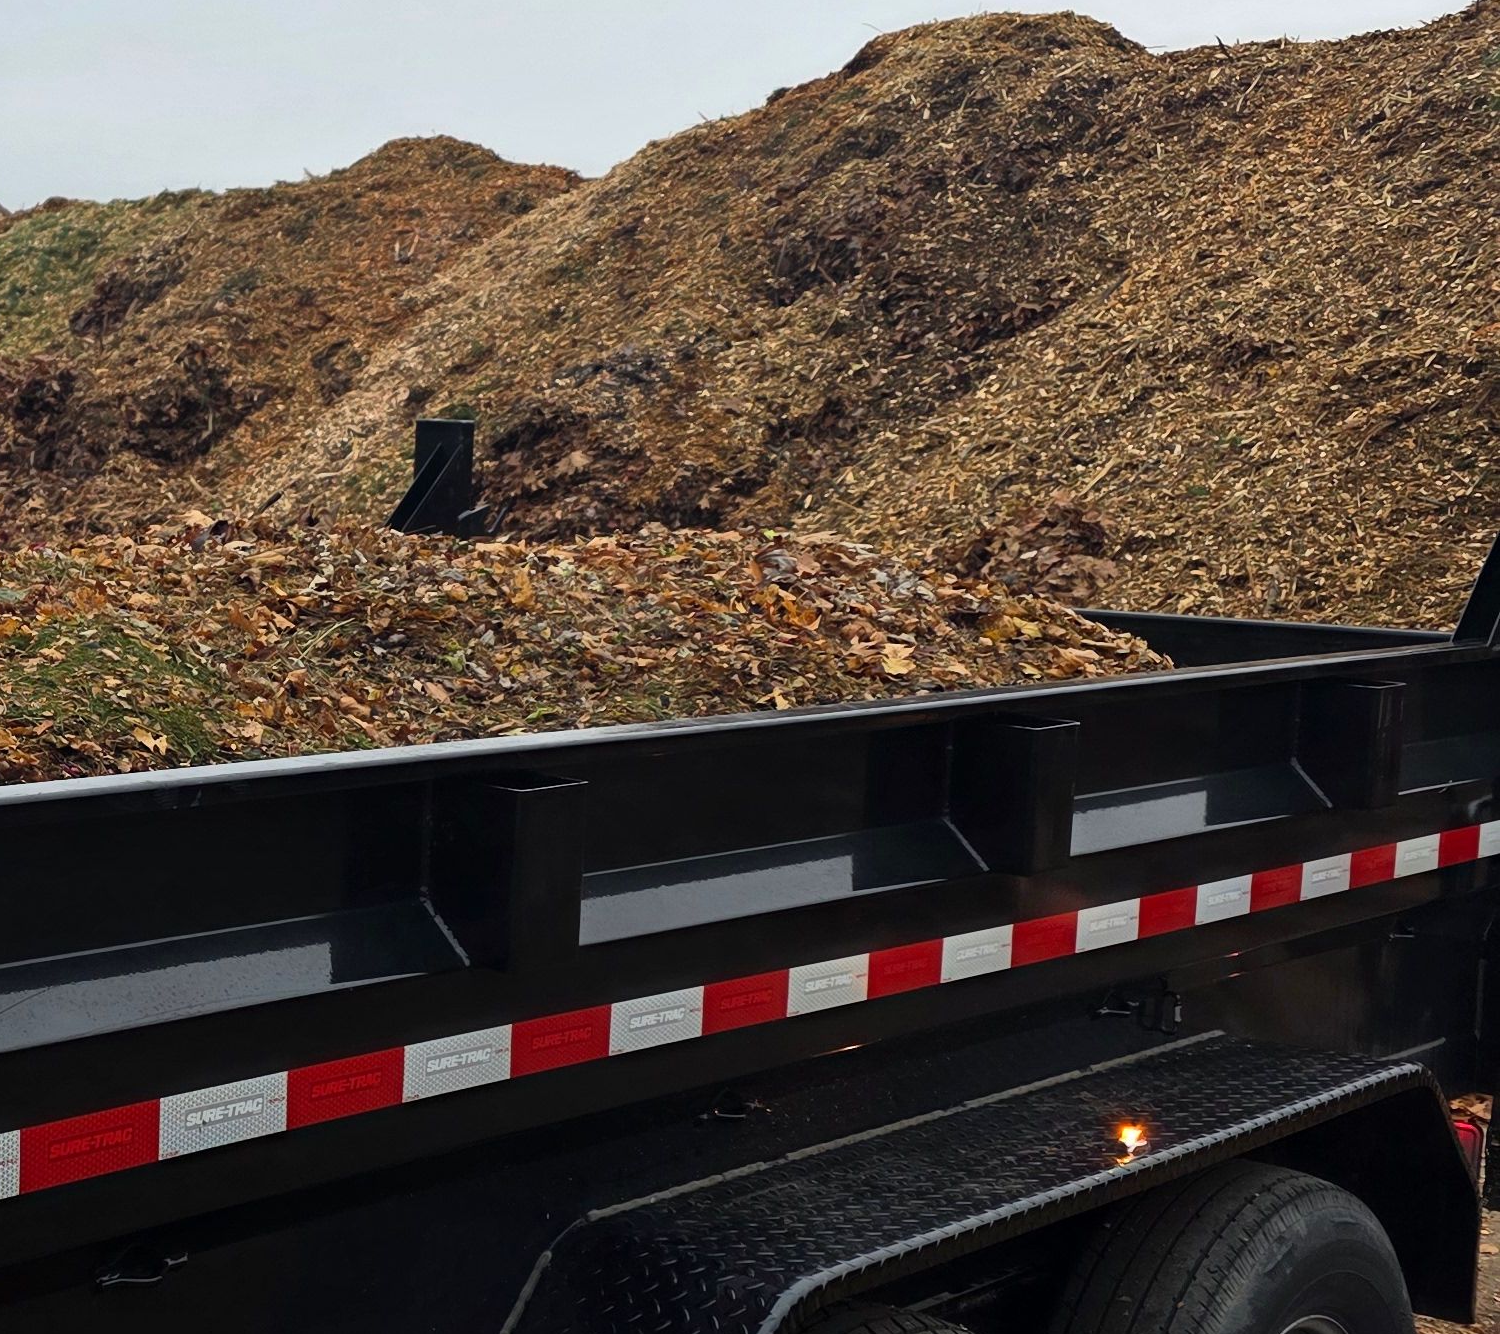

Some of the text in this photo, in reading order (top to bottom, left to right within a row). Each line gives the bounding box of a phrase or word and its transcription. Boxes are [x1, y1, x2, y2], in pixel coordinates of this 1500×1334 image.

[956, 943, 998, 960] SURE-TRAC
[805, 973, 852, 992] SURE-TRAC
[629, 1008, 685, 1029] SURE-TRAC
[532, 1027, 591, 1049] SURE-TRAC
[427, 1048, 491, 1073] SURE-TRAC
[312, 1072, 381, 1098] SURE-TRAC
[185, 1097, 263, 1126] SURE-TRAC
[49, 1128, 133, 1159] SURE-TRAC
